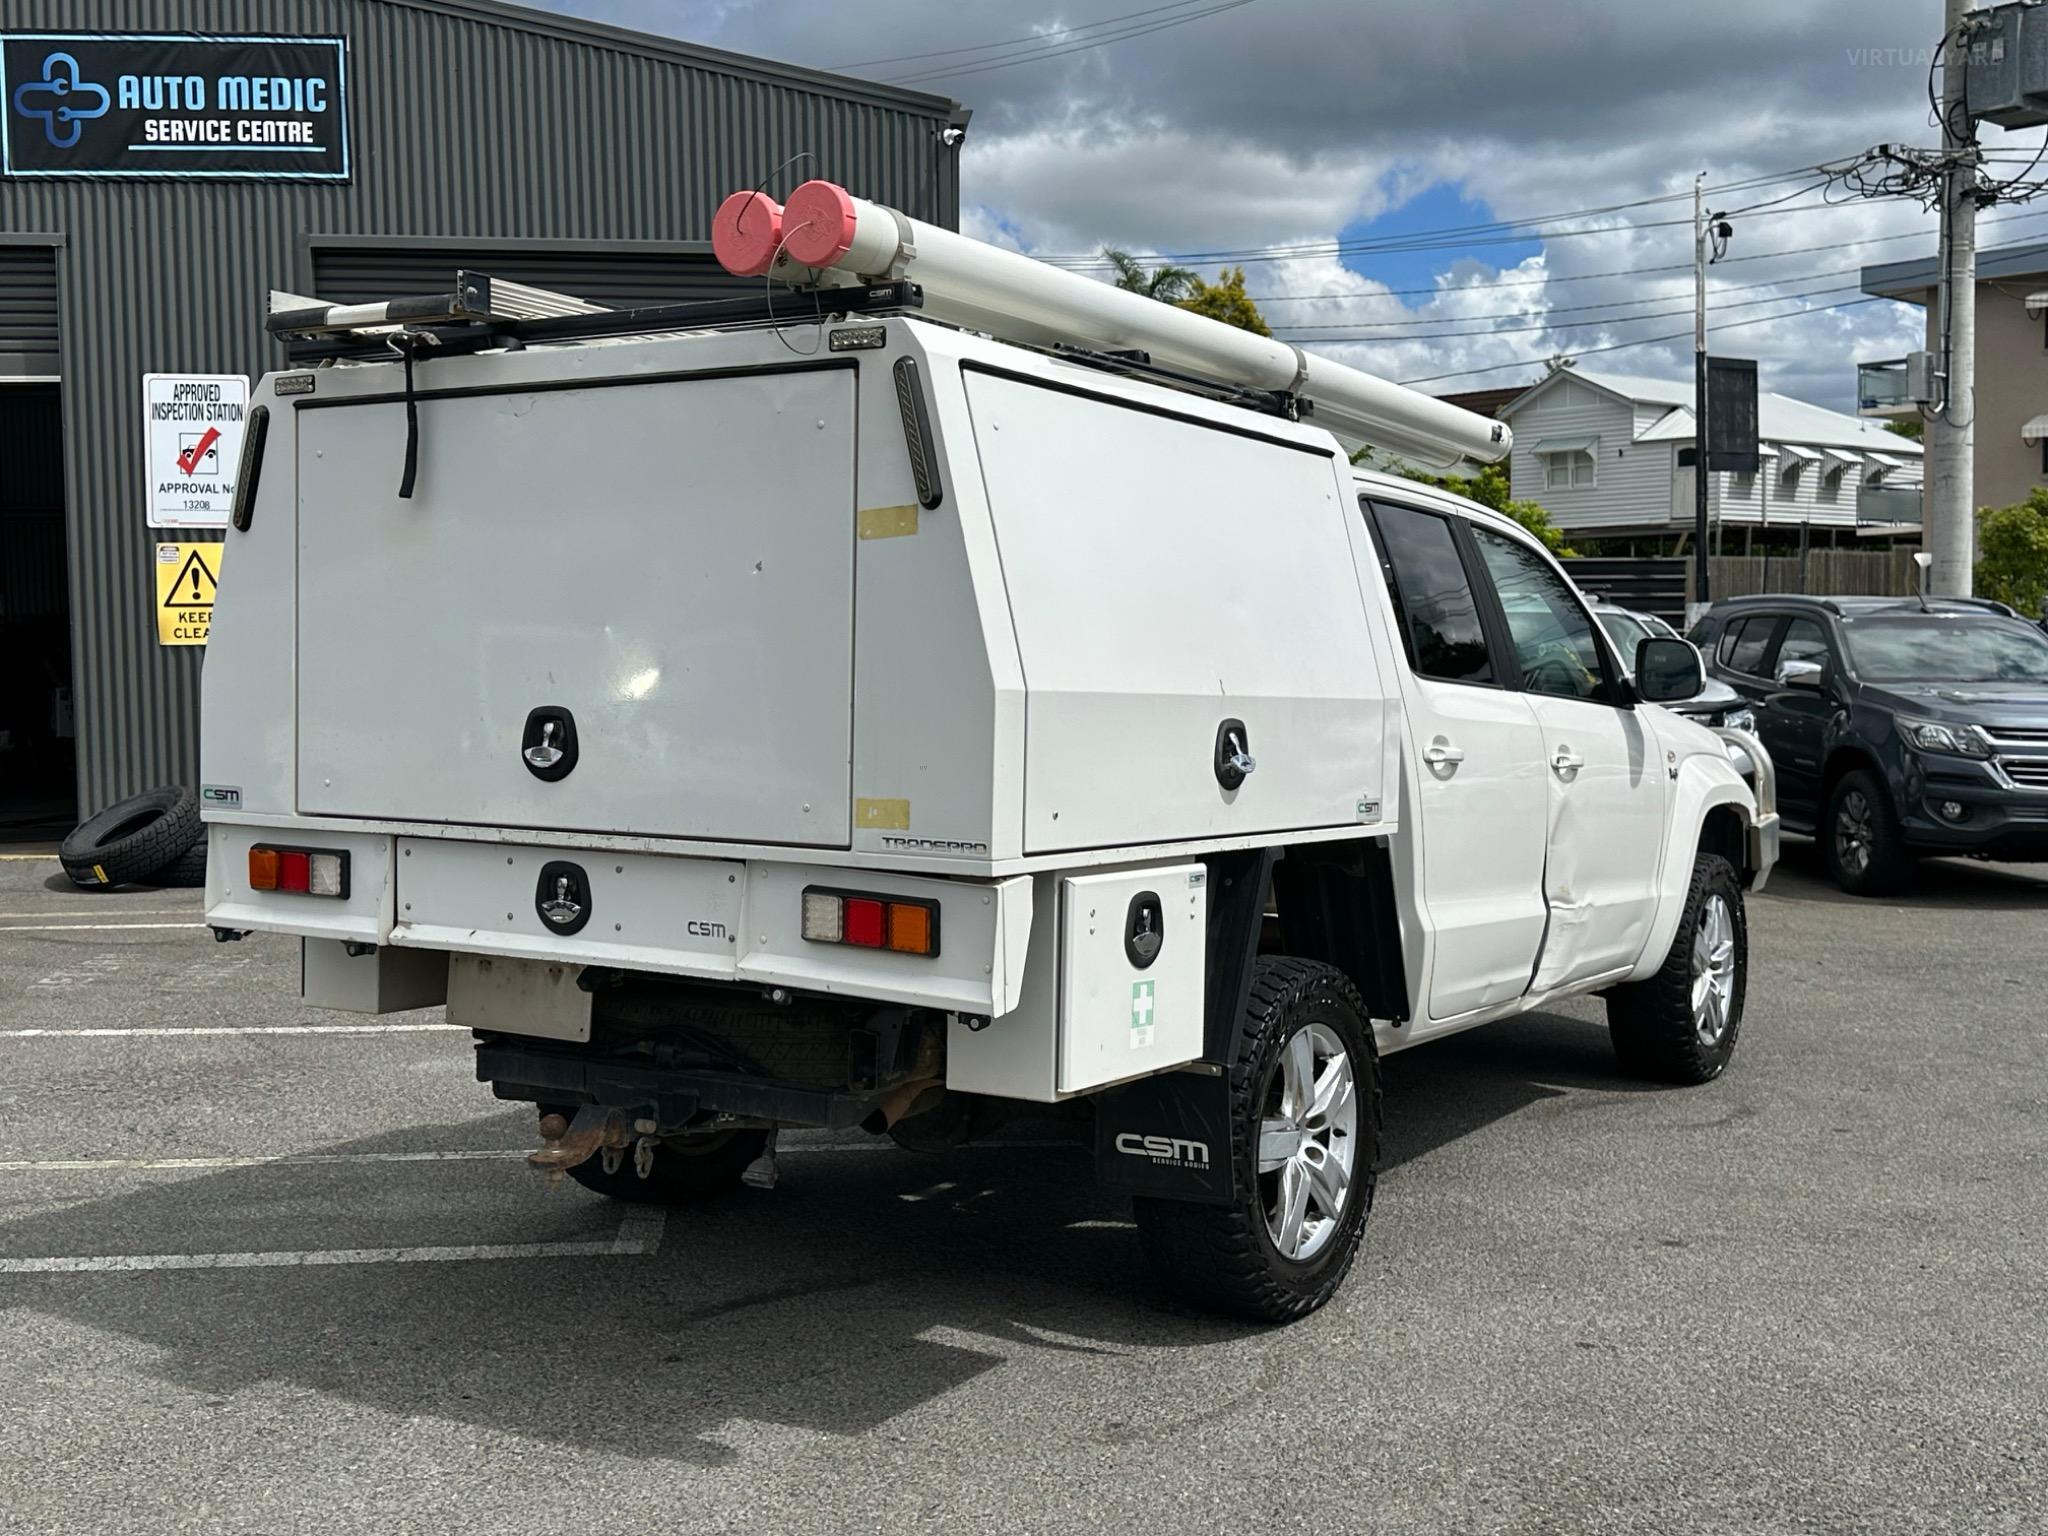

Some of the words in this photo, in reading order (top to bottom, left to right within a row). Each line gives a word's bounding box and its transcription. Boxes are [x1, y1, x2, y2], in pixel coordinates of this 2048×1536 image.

[118, 75, 205, 110] AUTO
[218, 76, 327, 112] MEDIC
[144, 119, 231, 142] SERVICE
[237, 120, 314, 143] CENTRE
[173, 383, 221, 402] APPROVED
[151, 402, 205, 421] INSPECTION
[206, 403, 243, 422] STATION
[159, 483, 219, 494] APPROVAL
